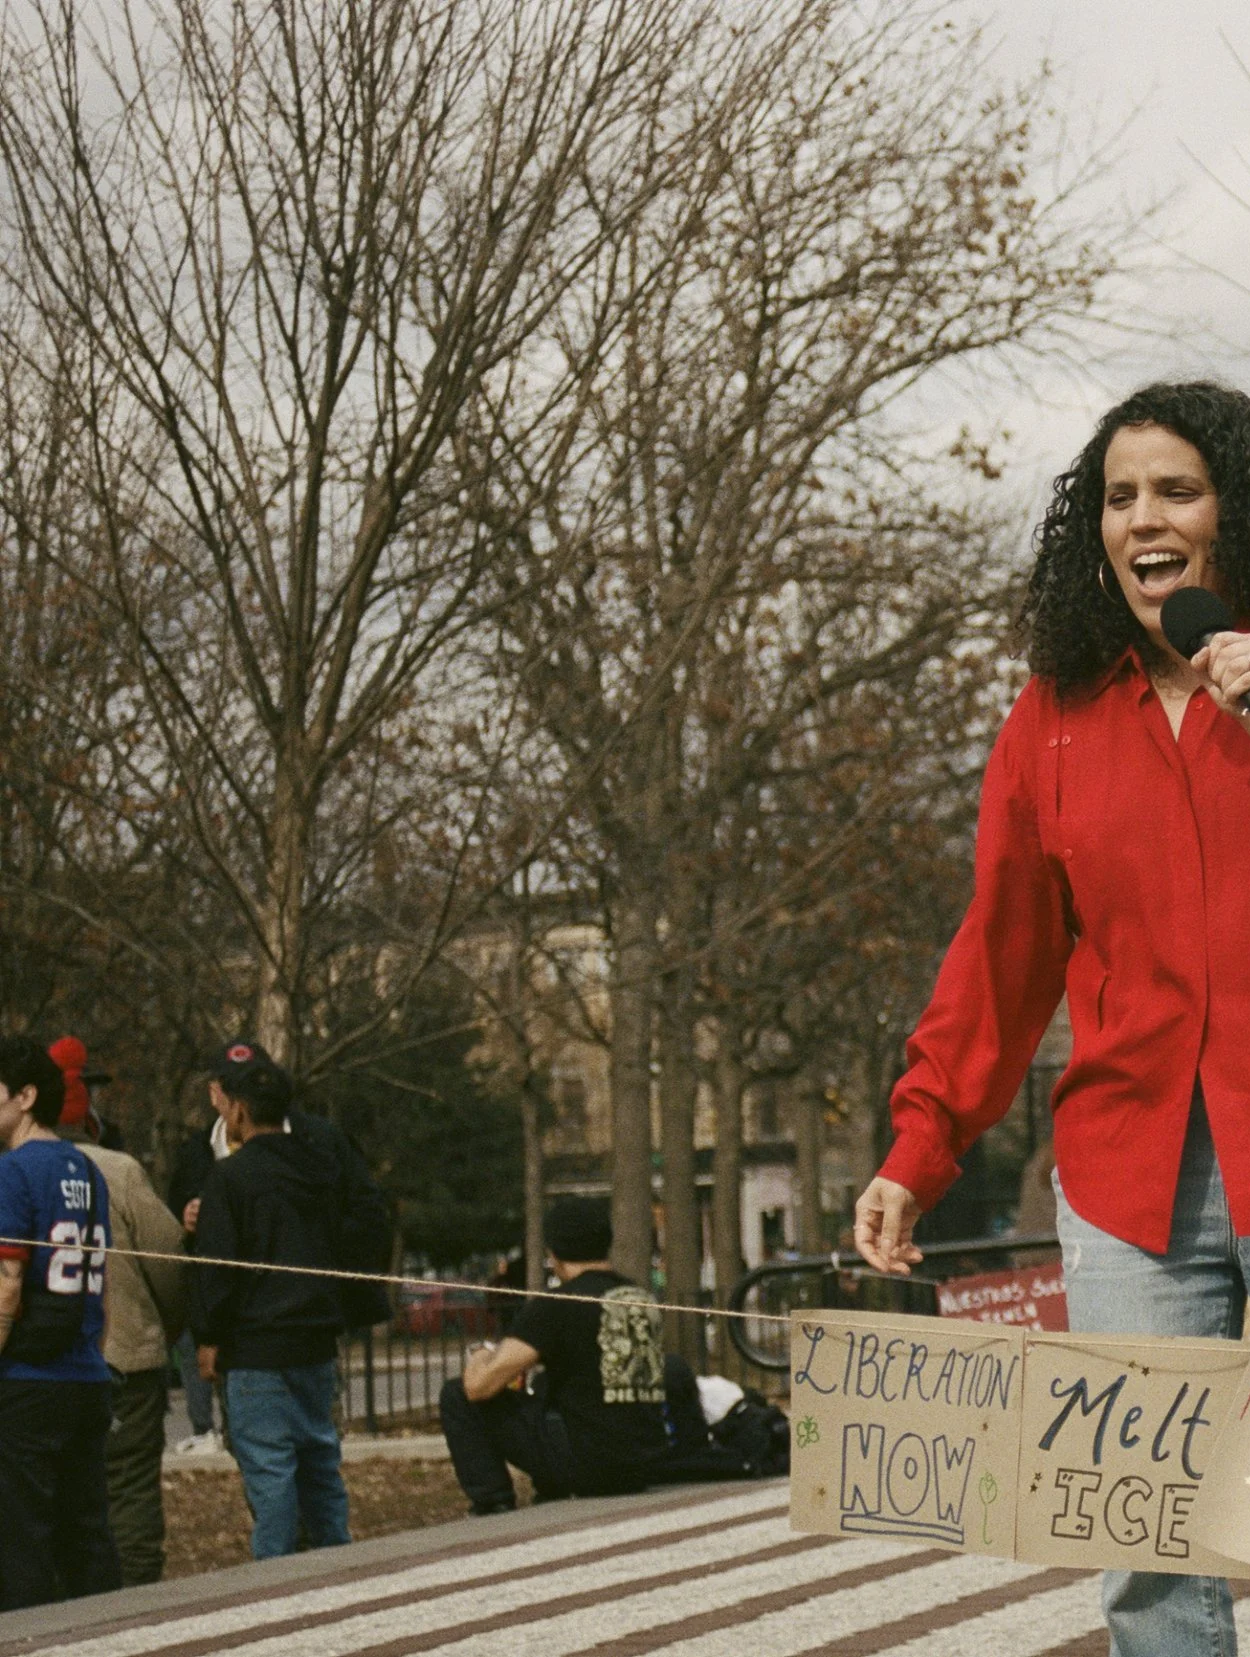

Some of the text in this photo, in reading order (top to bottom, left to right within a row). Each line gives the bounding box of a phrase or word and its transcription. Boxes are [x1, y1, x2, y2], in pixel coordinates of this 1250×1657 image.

[795, 1326, 1019, 1411] LIBERATION
[840, 1423, 975, 1525] NOW
[1038, 1374, 1211, 1481] Melt
[1051, 1468, 1200, 1559] ICE
